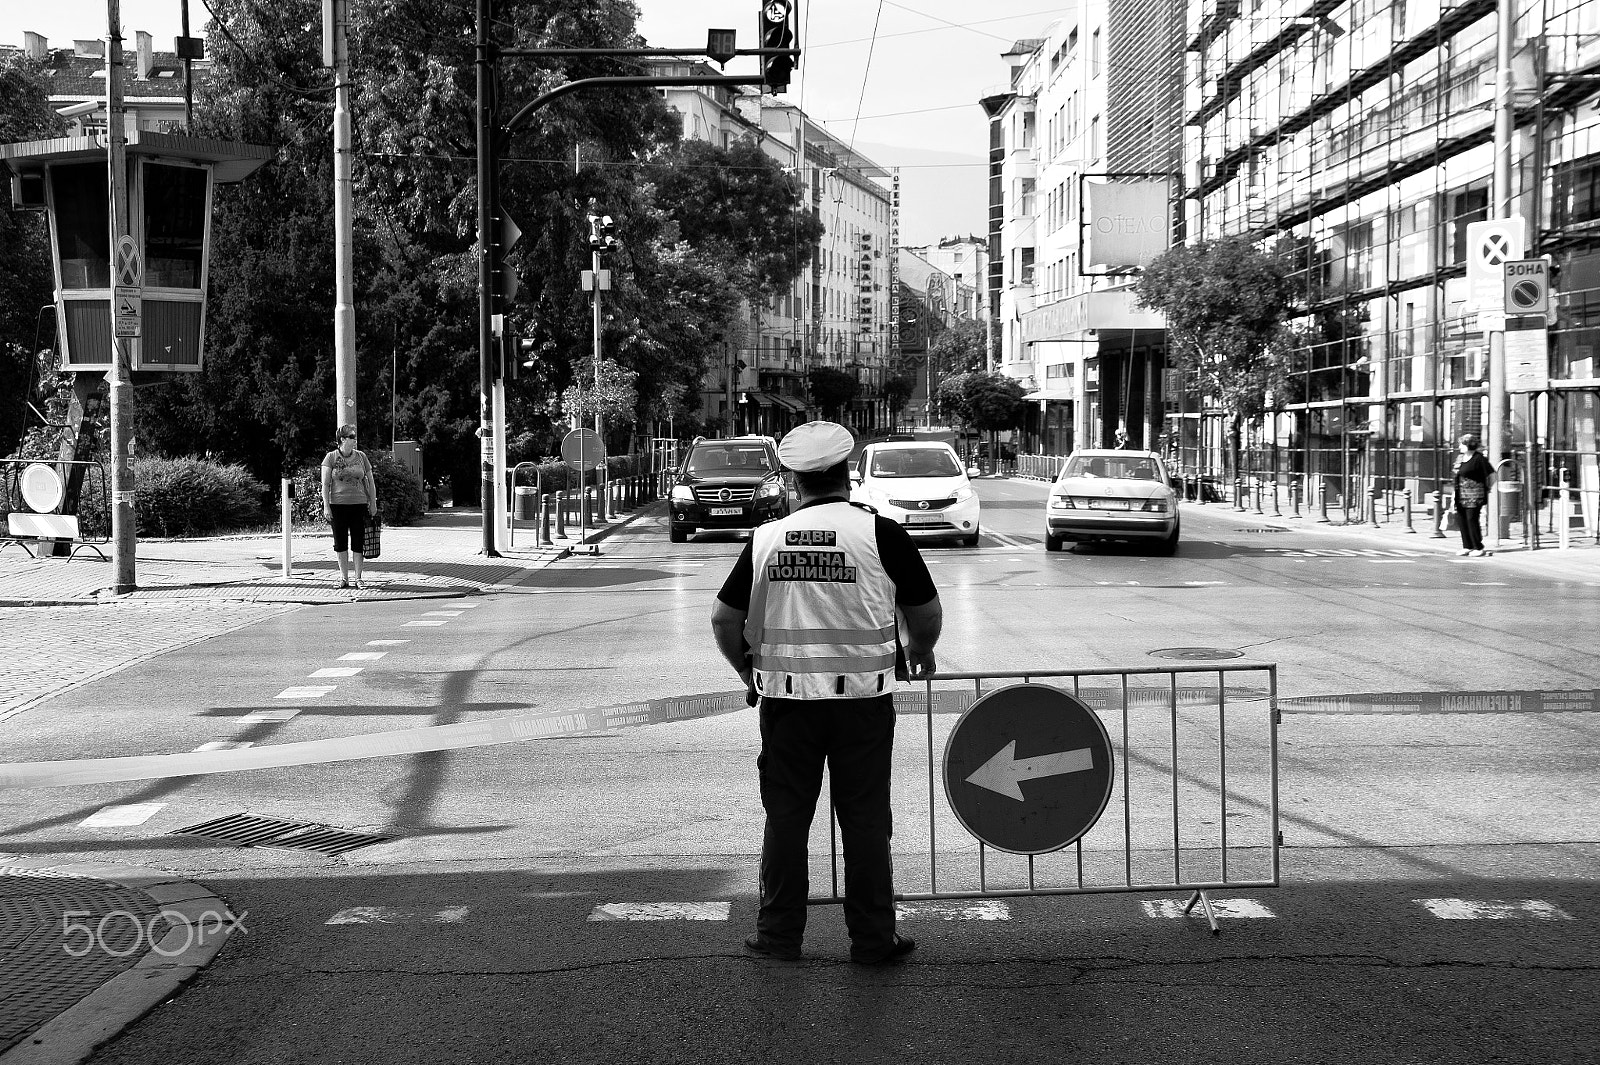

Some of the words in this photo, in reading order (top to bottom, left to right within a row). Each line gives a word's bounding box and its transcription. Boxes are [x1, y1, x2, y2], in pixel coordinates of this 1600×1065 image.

[1096, 213, 1166, 234] ОТЕЛО
[892, 209, 900, 291] СЛАВЯНСКА
[1507, 264, 1544, 276] ЗОНА
[786, 531, 835, 545] СДВР
[780, 552, 843, 566] ПЪТНА
[769, 566, 856, 581] ПОЛИЦИЯ
